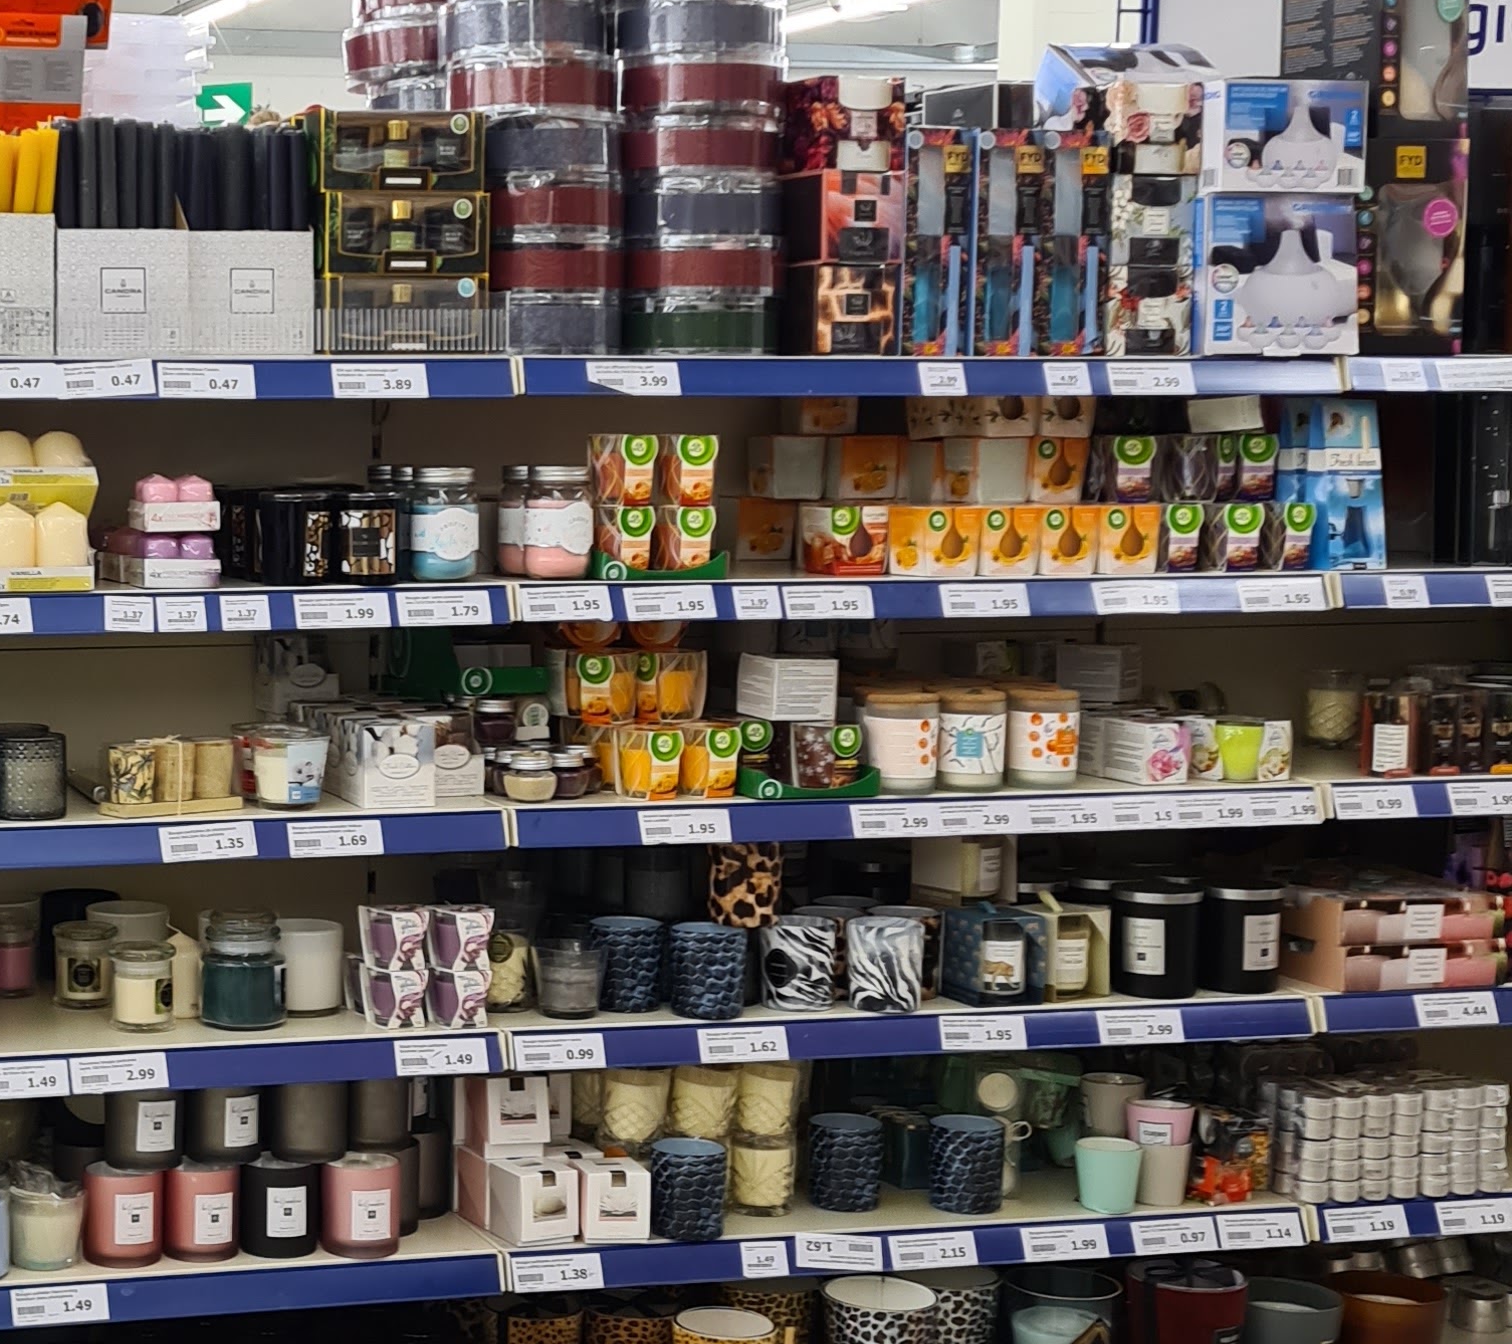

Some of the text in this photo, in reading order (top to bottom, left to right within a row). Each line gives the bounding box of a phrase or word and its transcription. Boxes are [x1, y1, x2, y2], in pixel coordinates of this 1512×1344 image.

[1399, 155, 1422, 166] FYD
[11, 378, 40, 388] 0.47
[111, 374, 140, 386] 0.47
[209, 379, 238, 389] 0.47
[383, 379, 411, 389] 3.89
[640, 376, 667, 386] 3.99
[1153, 377, 1180, 387] 2.99
[1142, 595, 1168, 605] 1.95
[1285, 594, 1310, 603] 1.95
[573, 600, 600, 610] 1.95
[677, 601, 704, 611] 1.95
[832, 600, 858, 610] 1.95
[992, 599, 1018, 609] 1.95
[123, 611, 142, 619] 1.37
[237, 609, 256, 617] 1.37
[346, 608, 374, 618] 1.99
[452, 606, 478, 616] 1.79
[1377, 799, 1402, 809] 0.99
[1218, 808, 1243, 818] 1.99
[1291, 805, 1317, 815] 1.99
[902, 818, 928, 828] 2.99
[983, 815, 1009, 824] 2.99
[1071, 813, 1097, 824] 1.95
[689, 824, 715, 834] 1.95
[216, 838, 244, 849] 1.35
[339, 835, 367, 846] 1.69
[1463, 1006, 1487, 1015] 4.44
[986, 1030, 1012, 1040] 1.95
[1147, 1025, 1172, 1035] 2.99
[750, 1041, 777, 1052] 1.62
[567, 1049, 593, 1059] 0.99
[445, 1054, 472, 1065] 1.49
[126, 1069, 155, 1080] 2.99
[28, 1076, 56, 1087] 1.49
[1481, 1214, 1504, 1224] 1.19
[1370, 1221, 1394, 1231] 1.19
[1181, 1232, 1205, 1243] 0.97
[1266, 1229, 1291, 1238] 1.14
[806, 1241, 832, 1252] 1.62
[1072, 1239, 1096, 1250] 1.99
[940, 1247, 966, 1258] 2.15
[561, 1269, 587, 1280] 1.38
[64, 1300, 92, 1312] 1.49
